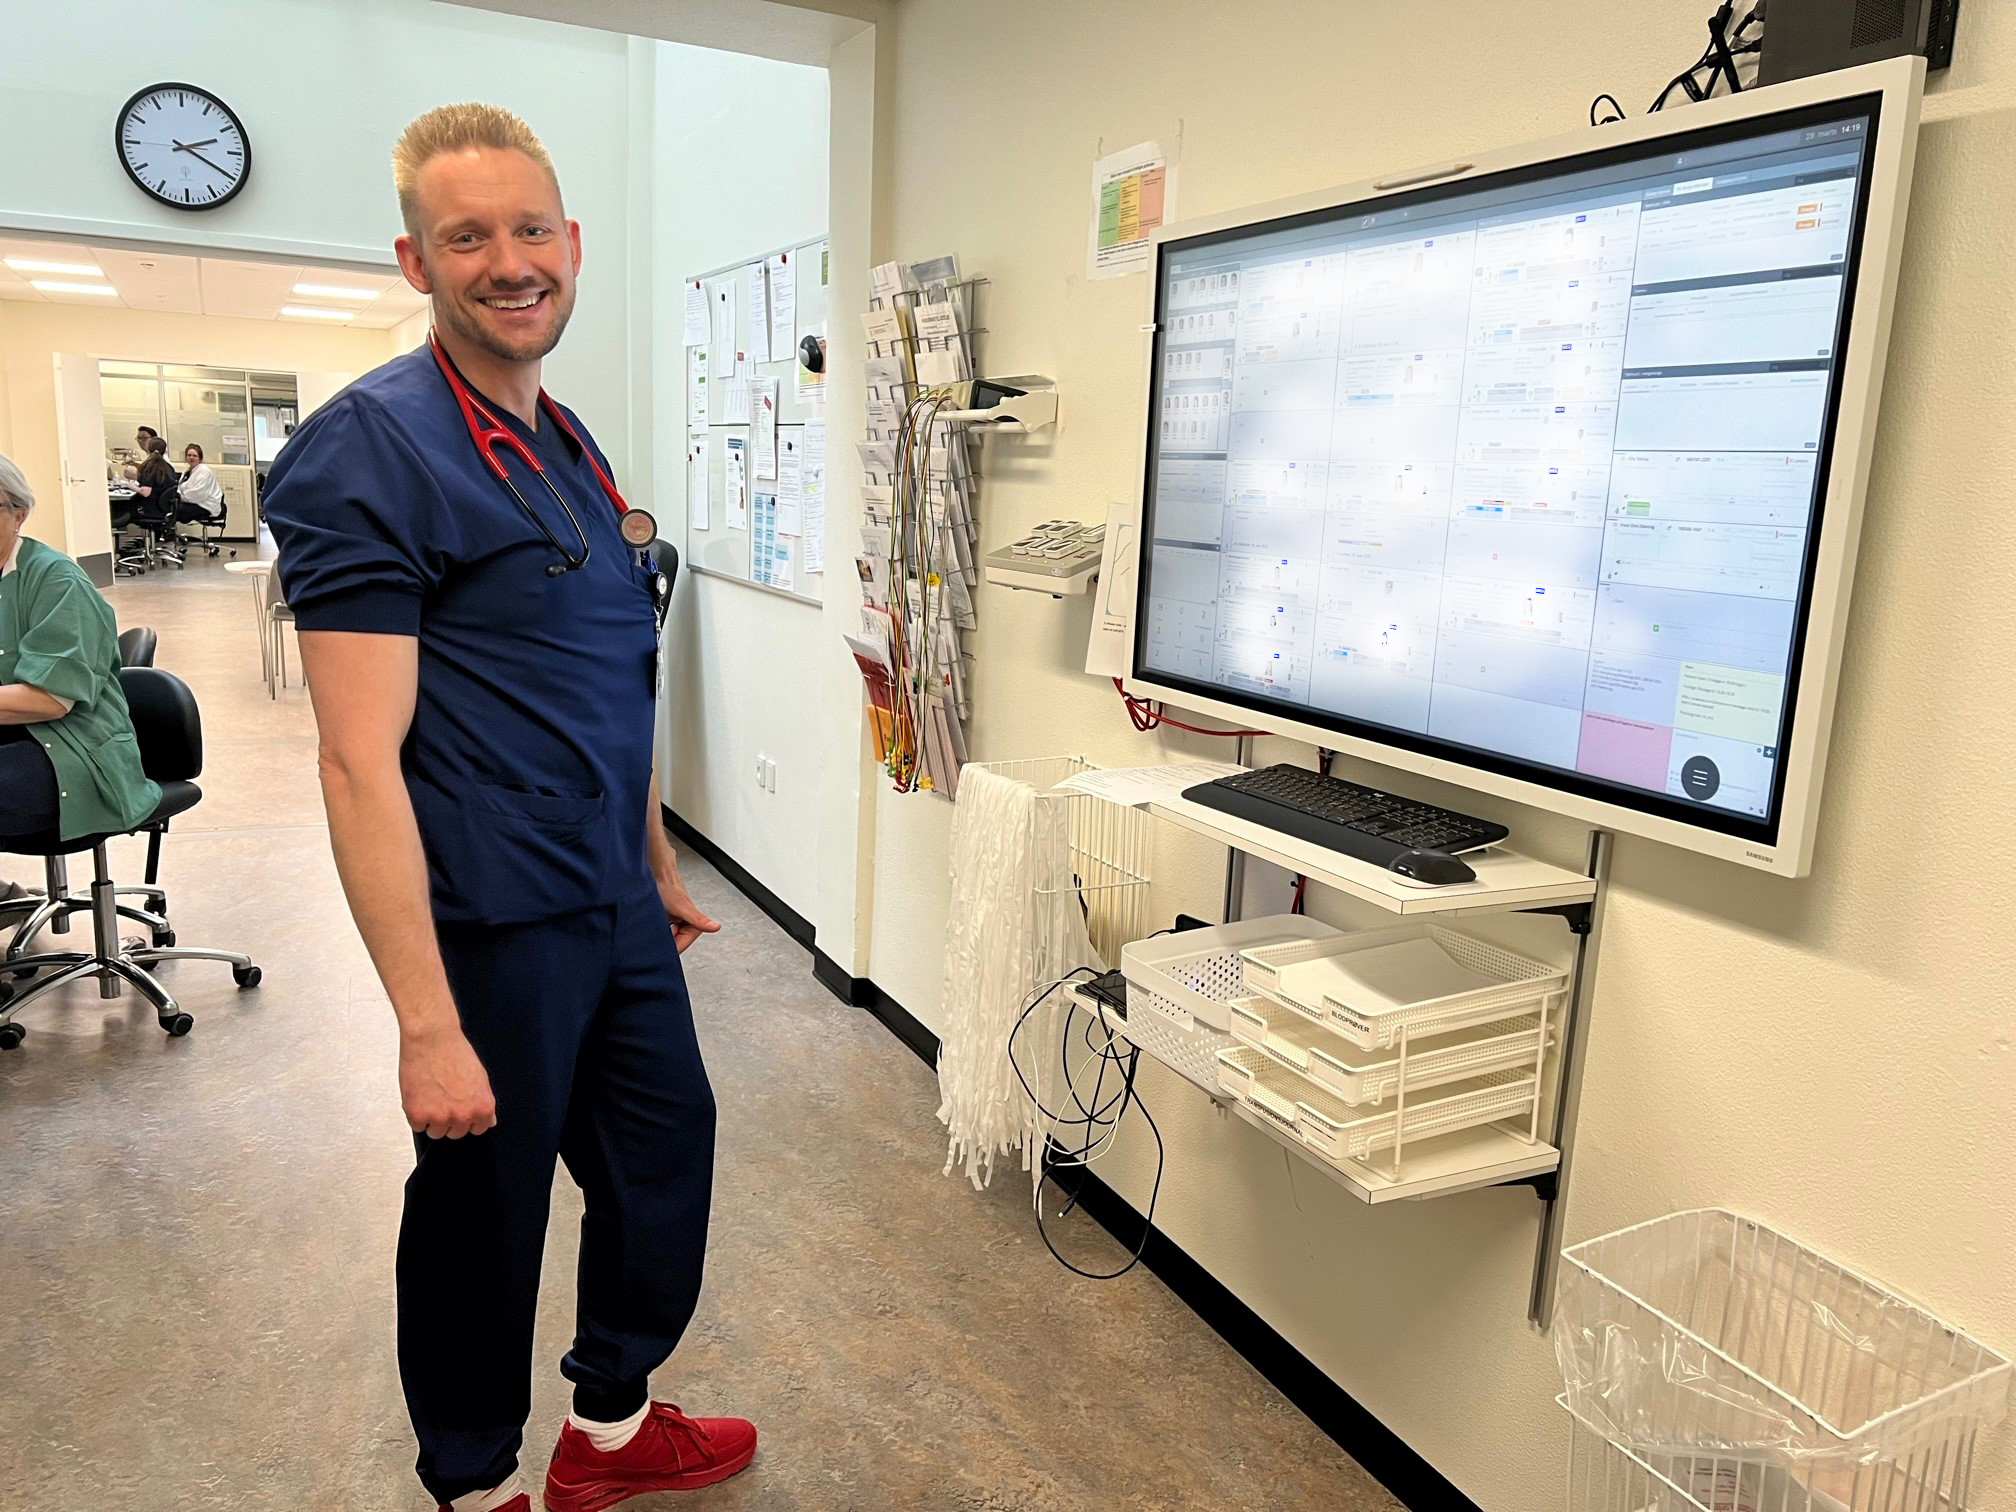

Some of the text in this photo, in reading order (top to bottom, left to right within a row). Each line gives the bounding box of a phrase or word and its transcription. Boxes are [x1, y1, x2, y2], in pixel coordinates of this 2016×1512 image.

[1841, 123, 1861, 133] 14:19
[1746, 851, 1773, 863] SAMSUNG
[1244, 1095, 1304, 1138] TRANSFUSIONSJOURNAL
